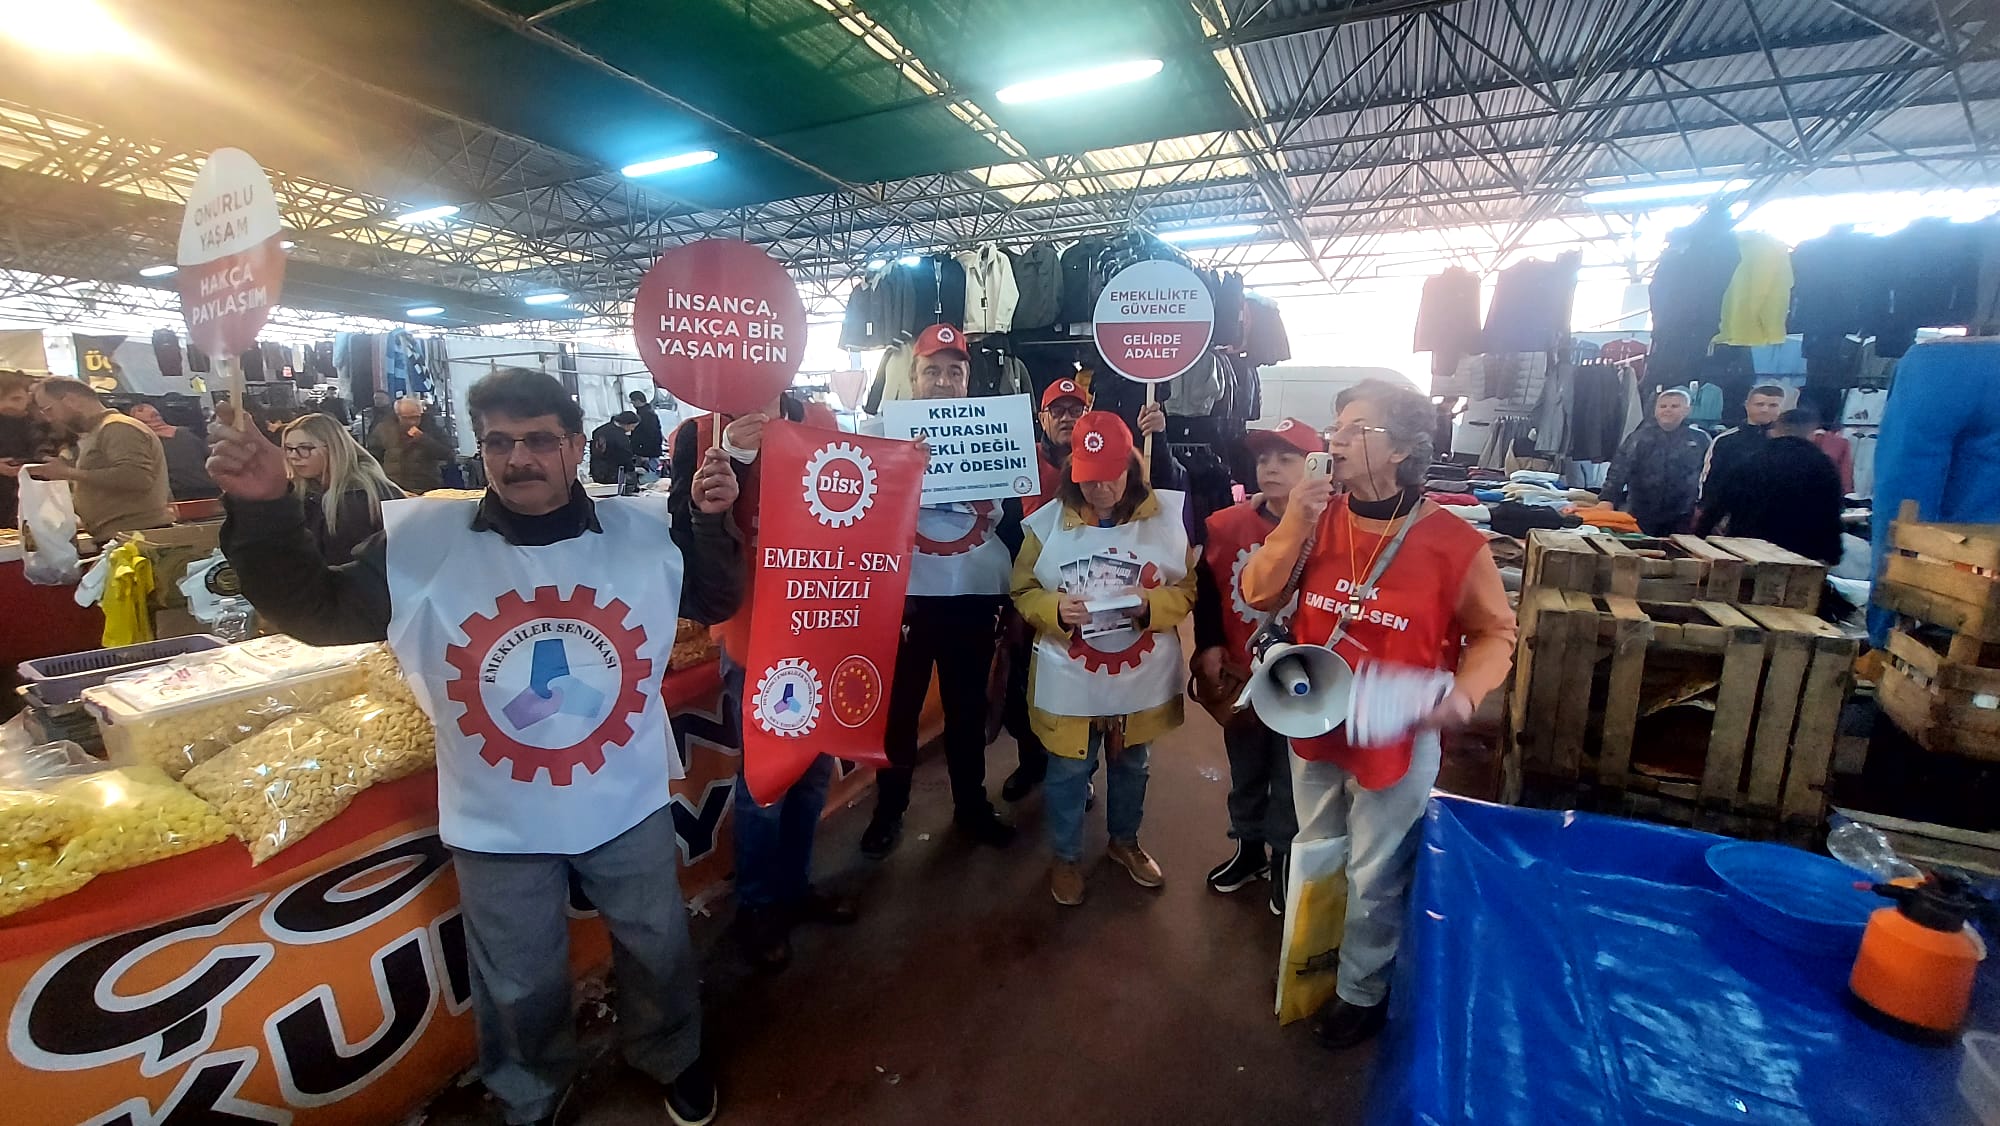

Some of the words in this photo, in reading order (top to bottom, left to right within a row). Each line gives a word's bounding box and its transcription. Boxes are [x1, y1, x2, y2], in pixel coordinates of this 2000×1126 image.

[193, 185, 254, 226] ONURLU
[200, 216, 249, 251] YAŞAM
[200, 262, 254, 297] HAKÇA
[192, 286, 267, 326] PAYLAŞIM
[668, 289, 778, 320] İNSANCA,
[1110, 288, 1198, 302] EMEKLİLİKTE
[1120, 303, 1186, 315] GÜVENCE
[660, 315, 740, 338] HAKÇA
[748, 320, 784, 340] BİR
[1123, 332, 1181, 345] GELİRDE
[656, 338, 734, 360] YAŞAM
[742, 340, 787, 364] İÇİN
[1124, 348, 1179, 359] ADALET
[928, 404, 986, 419] KRİZİN
[910, 423, 1008, 438] FATURASINI
[929, 440, 965, 456] EKLİ
[970, 439, 1020, 454] DEĞİL
[923, 462, 955, 476] RAY
[960, 456, 1027, 473] ÖDESİN!
[818, 470, 863, 495] DİSK
[763, 546, 845, 570] EMEKLİ
[859, 552, 902, 573] SEN
[786, 575, 872, 600] DENİZLİ
[790, 605, 861, 636] ŞUBESİ
[485, 622, 552, 684] EMEKLİLER
[556, 623, 617, 670] SENDİKASI
